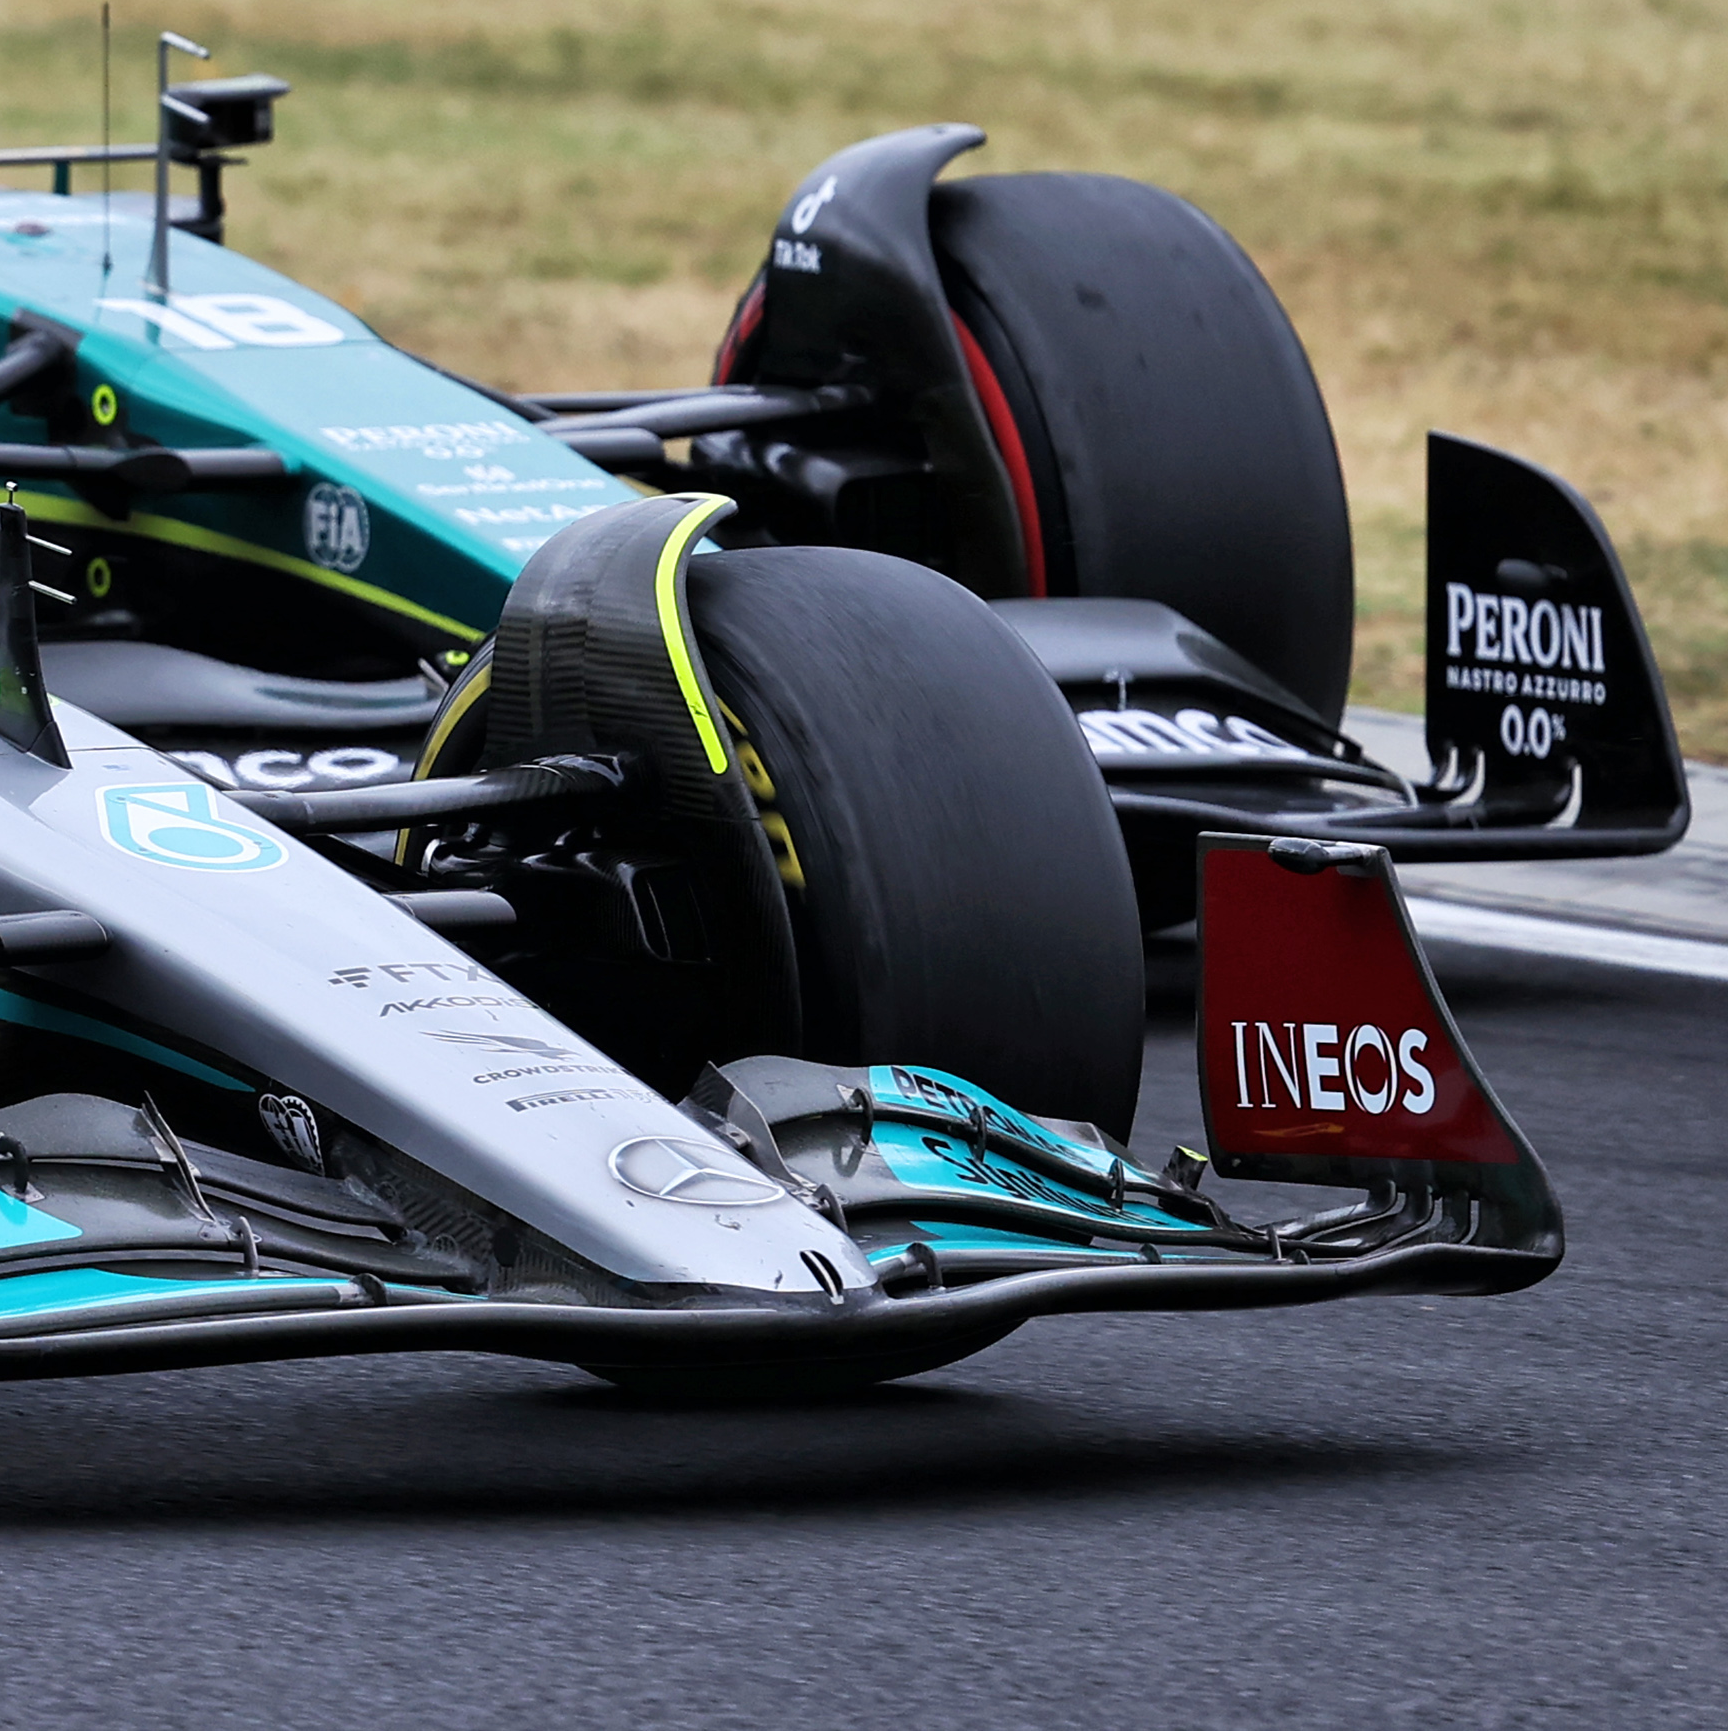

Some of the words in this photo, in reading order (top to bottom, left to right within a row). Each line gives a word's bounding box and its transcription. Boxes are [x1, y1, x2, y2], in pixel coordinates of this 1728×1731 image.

[92, 292, 345, 350] 18
[1446, 581, 1606, 673] PERONI
[1446, 666, 1518, 696] NASTRO
[1520, 674, 1607, 706] AZZURRO
[377, 963, 504, 984] FTX
[1230, 1021, 1436, 1115] INEOS
